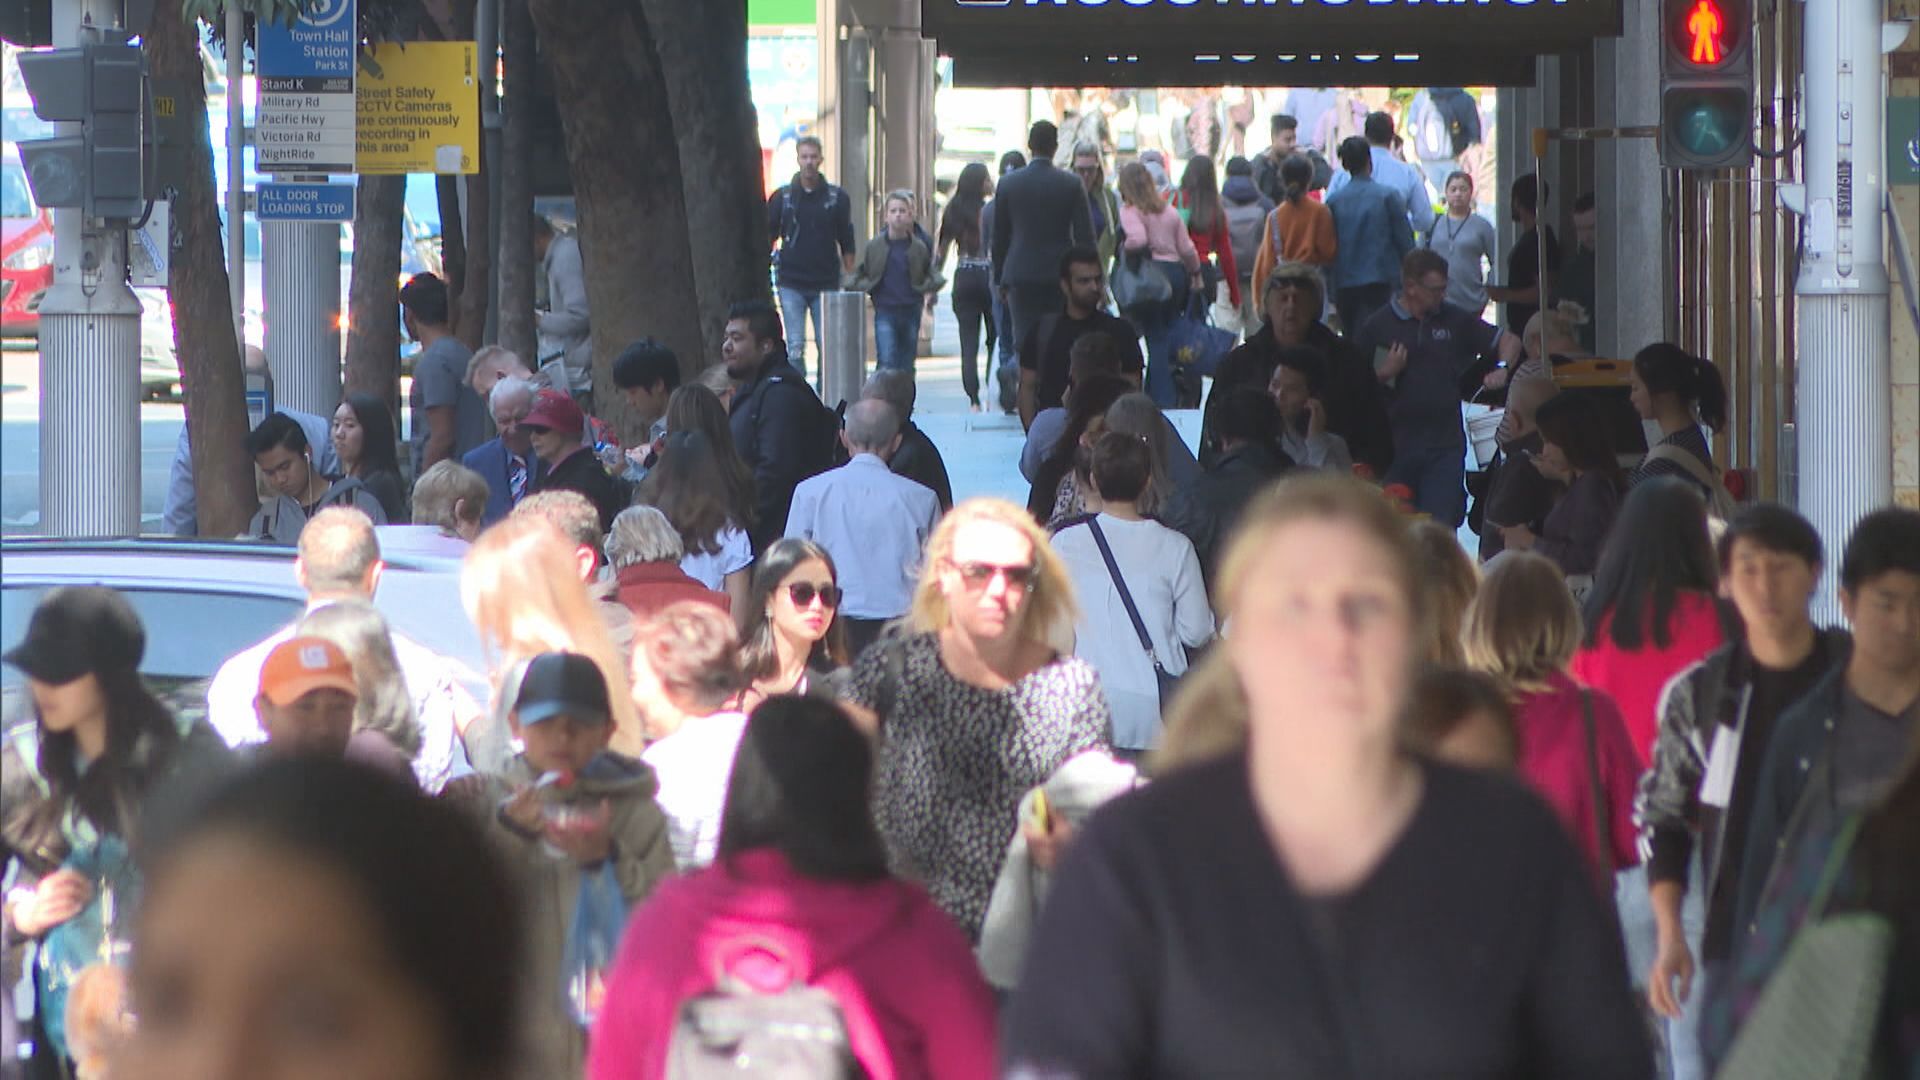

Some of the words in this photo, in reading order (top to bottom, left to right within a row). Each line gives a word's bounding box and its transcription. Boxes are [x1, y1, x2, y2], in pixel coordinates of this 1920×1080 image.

[289, 30, 321, 42] Town
[325, 29, 349, 42] Hall
[304, 45, 349, 58] Station
[315, 61, 336, 71] Park
[338, 61, 348, 71] St
[261, 79, 294, 90] Stand
[296, 79, 304, 90] K
[395, 87, 435, 99] Safety
[261, 96, 303, 109] Military
[307, 96, 320, 107] Rd
[395, 101, 452, 112] Cameras
[261, 113, 298, 125] Pacific
[301, 114, 325, 126] Hwy
[378, 114, 459, 127] continuously
[261, 131, 304, 143] Victoria
[307, 131, 321, 142] Rd
[418, 129, 430, 139] in
[381, 143, 409, 153] area
[261, 148, 315, 161] NightRide
[262, 190, 282, 200] ALL
[287, 190, 319, 200] DOOR
[262, 203, 311, 214] LOADING
[316, 203, 345, 214] STOP
